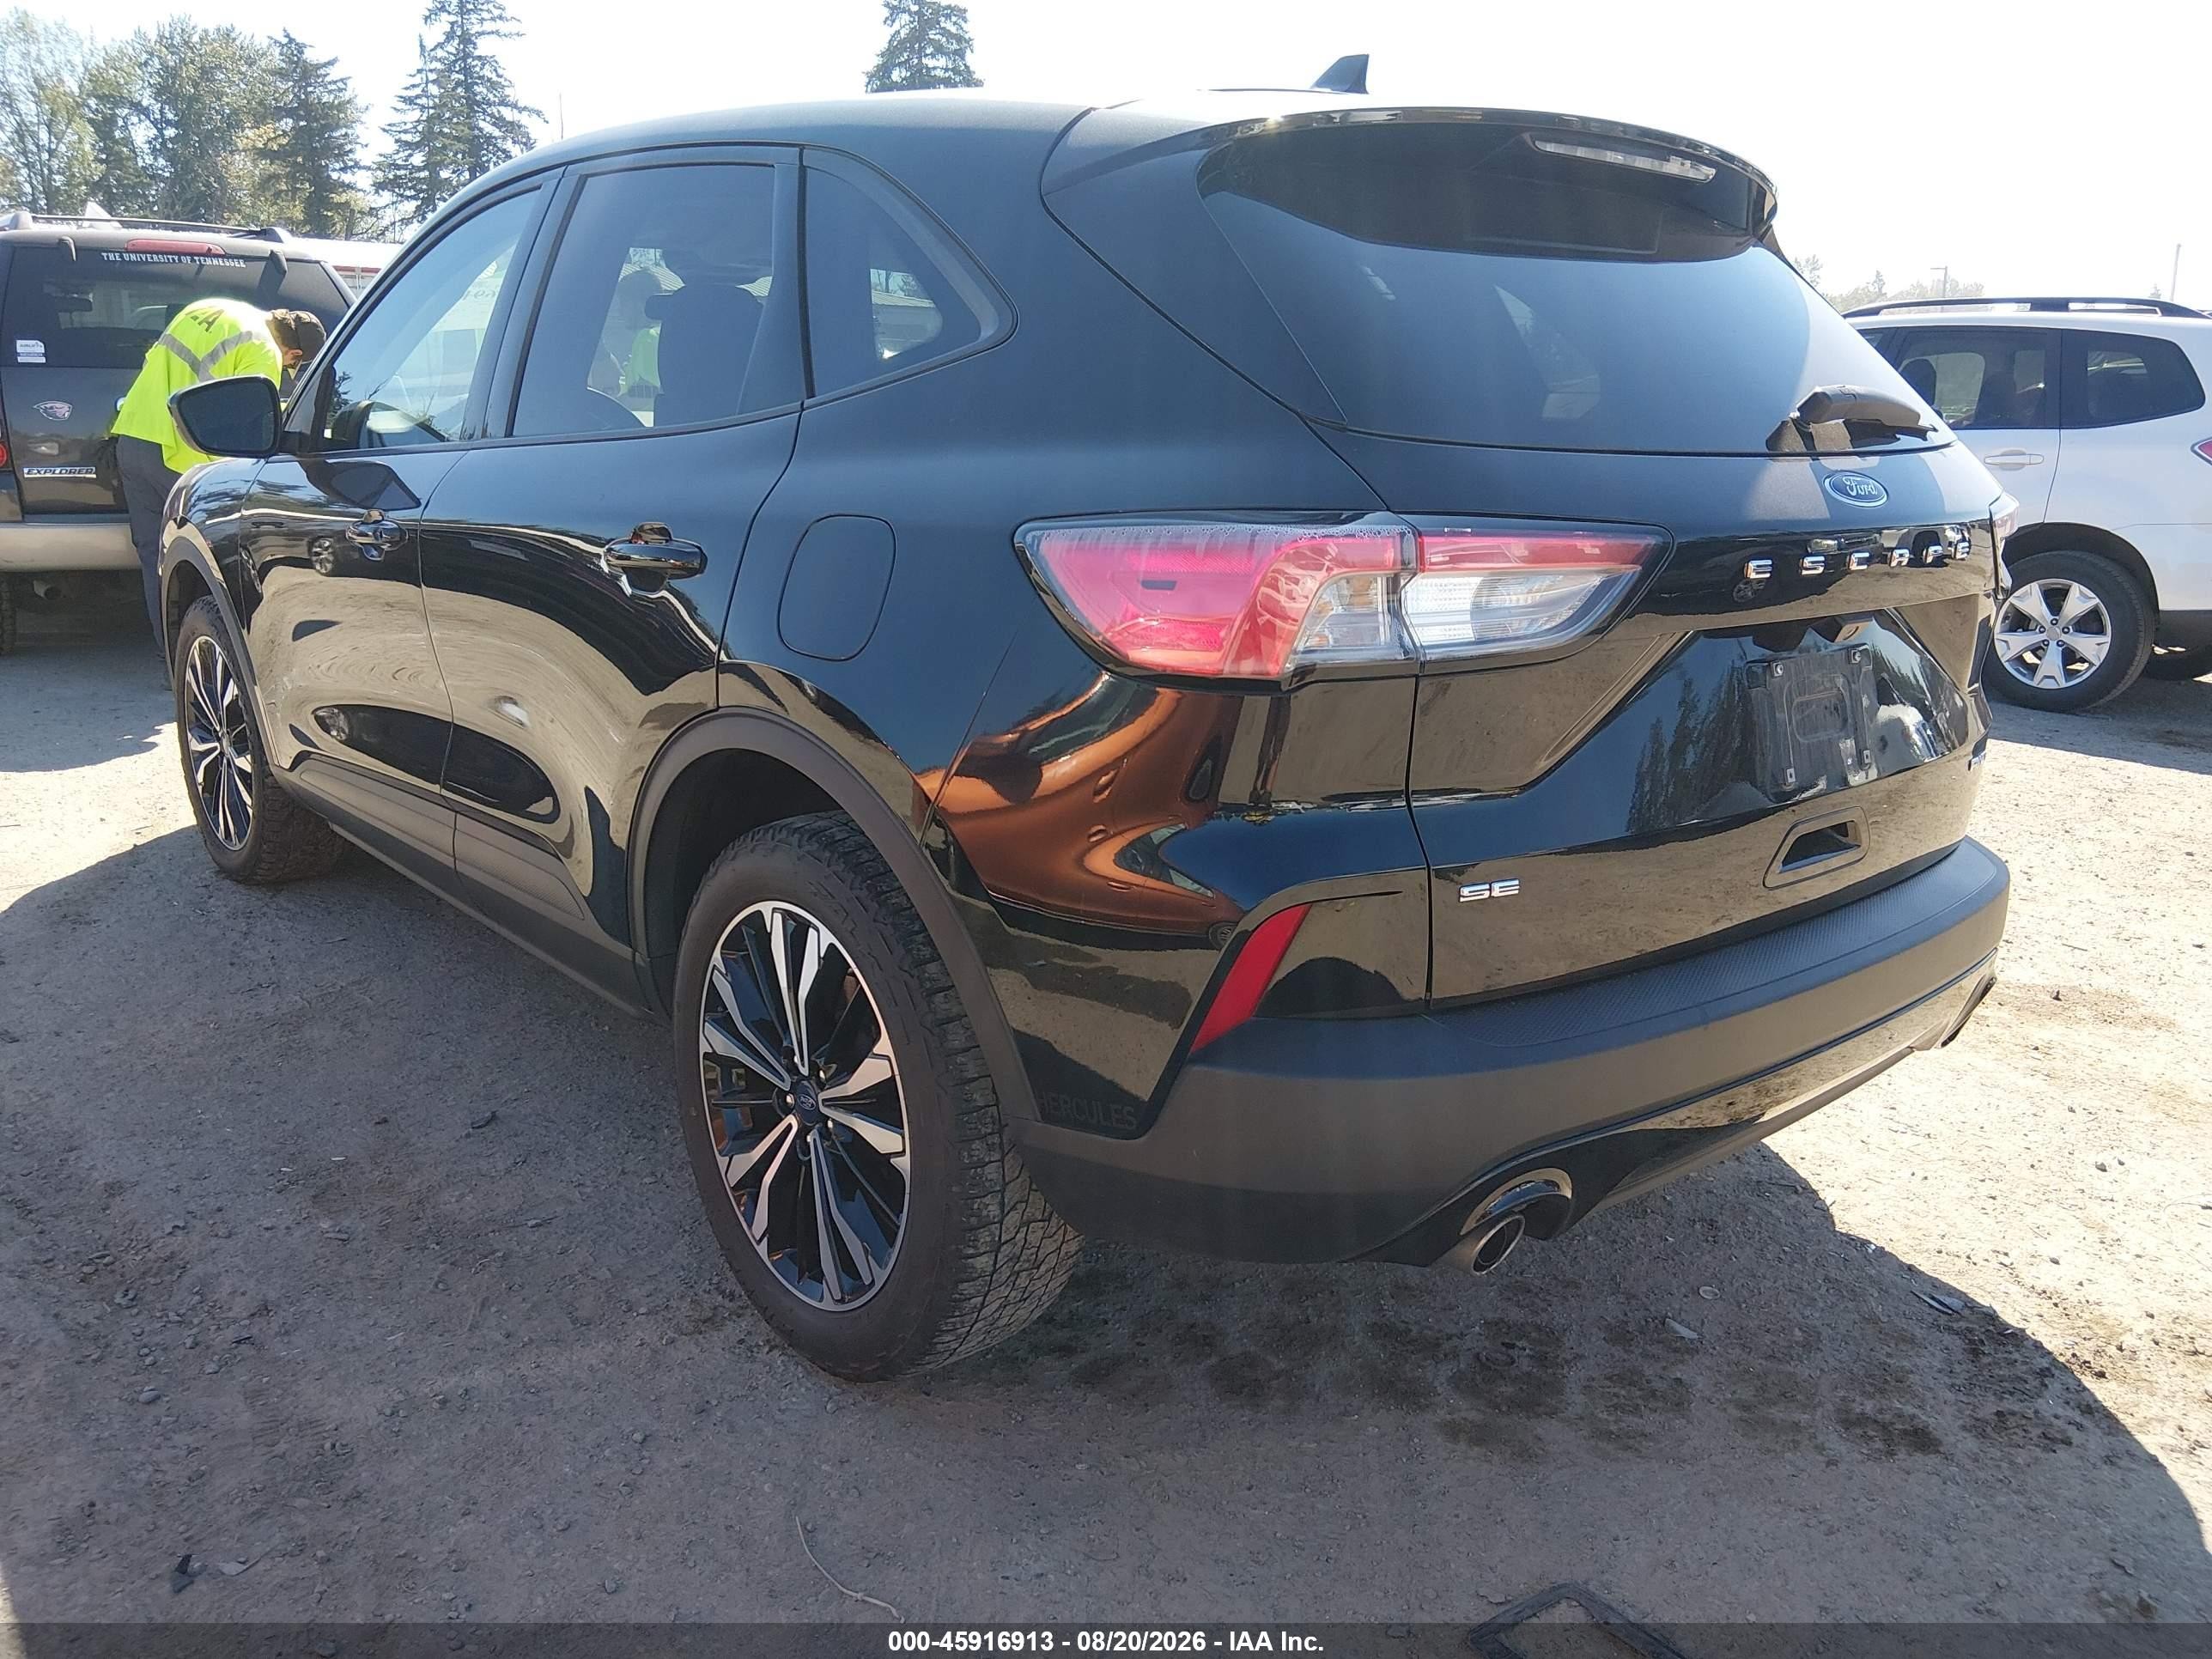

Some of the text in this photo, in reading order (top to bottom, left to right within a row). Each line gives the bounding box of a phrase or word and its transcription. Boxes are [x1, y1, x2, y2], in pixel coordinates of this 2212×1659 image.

[101, 252, 246, 268] THE UNIVERSITY OF TENNESSEE
[25, 467, 95, 476] EXPLORER
[1842, 477, 1878, 495] Ford
[1744, 542, 1971, 579] ESCAPE
[1459, 878, 1520, 902] SE
